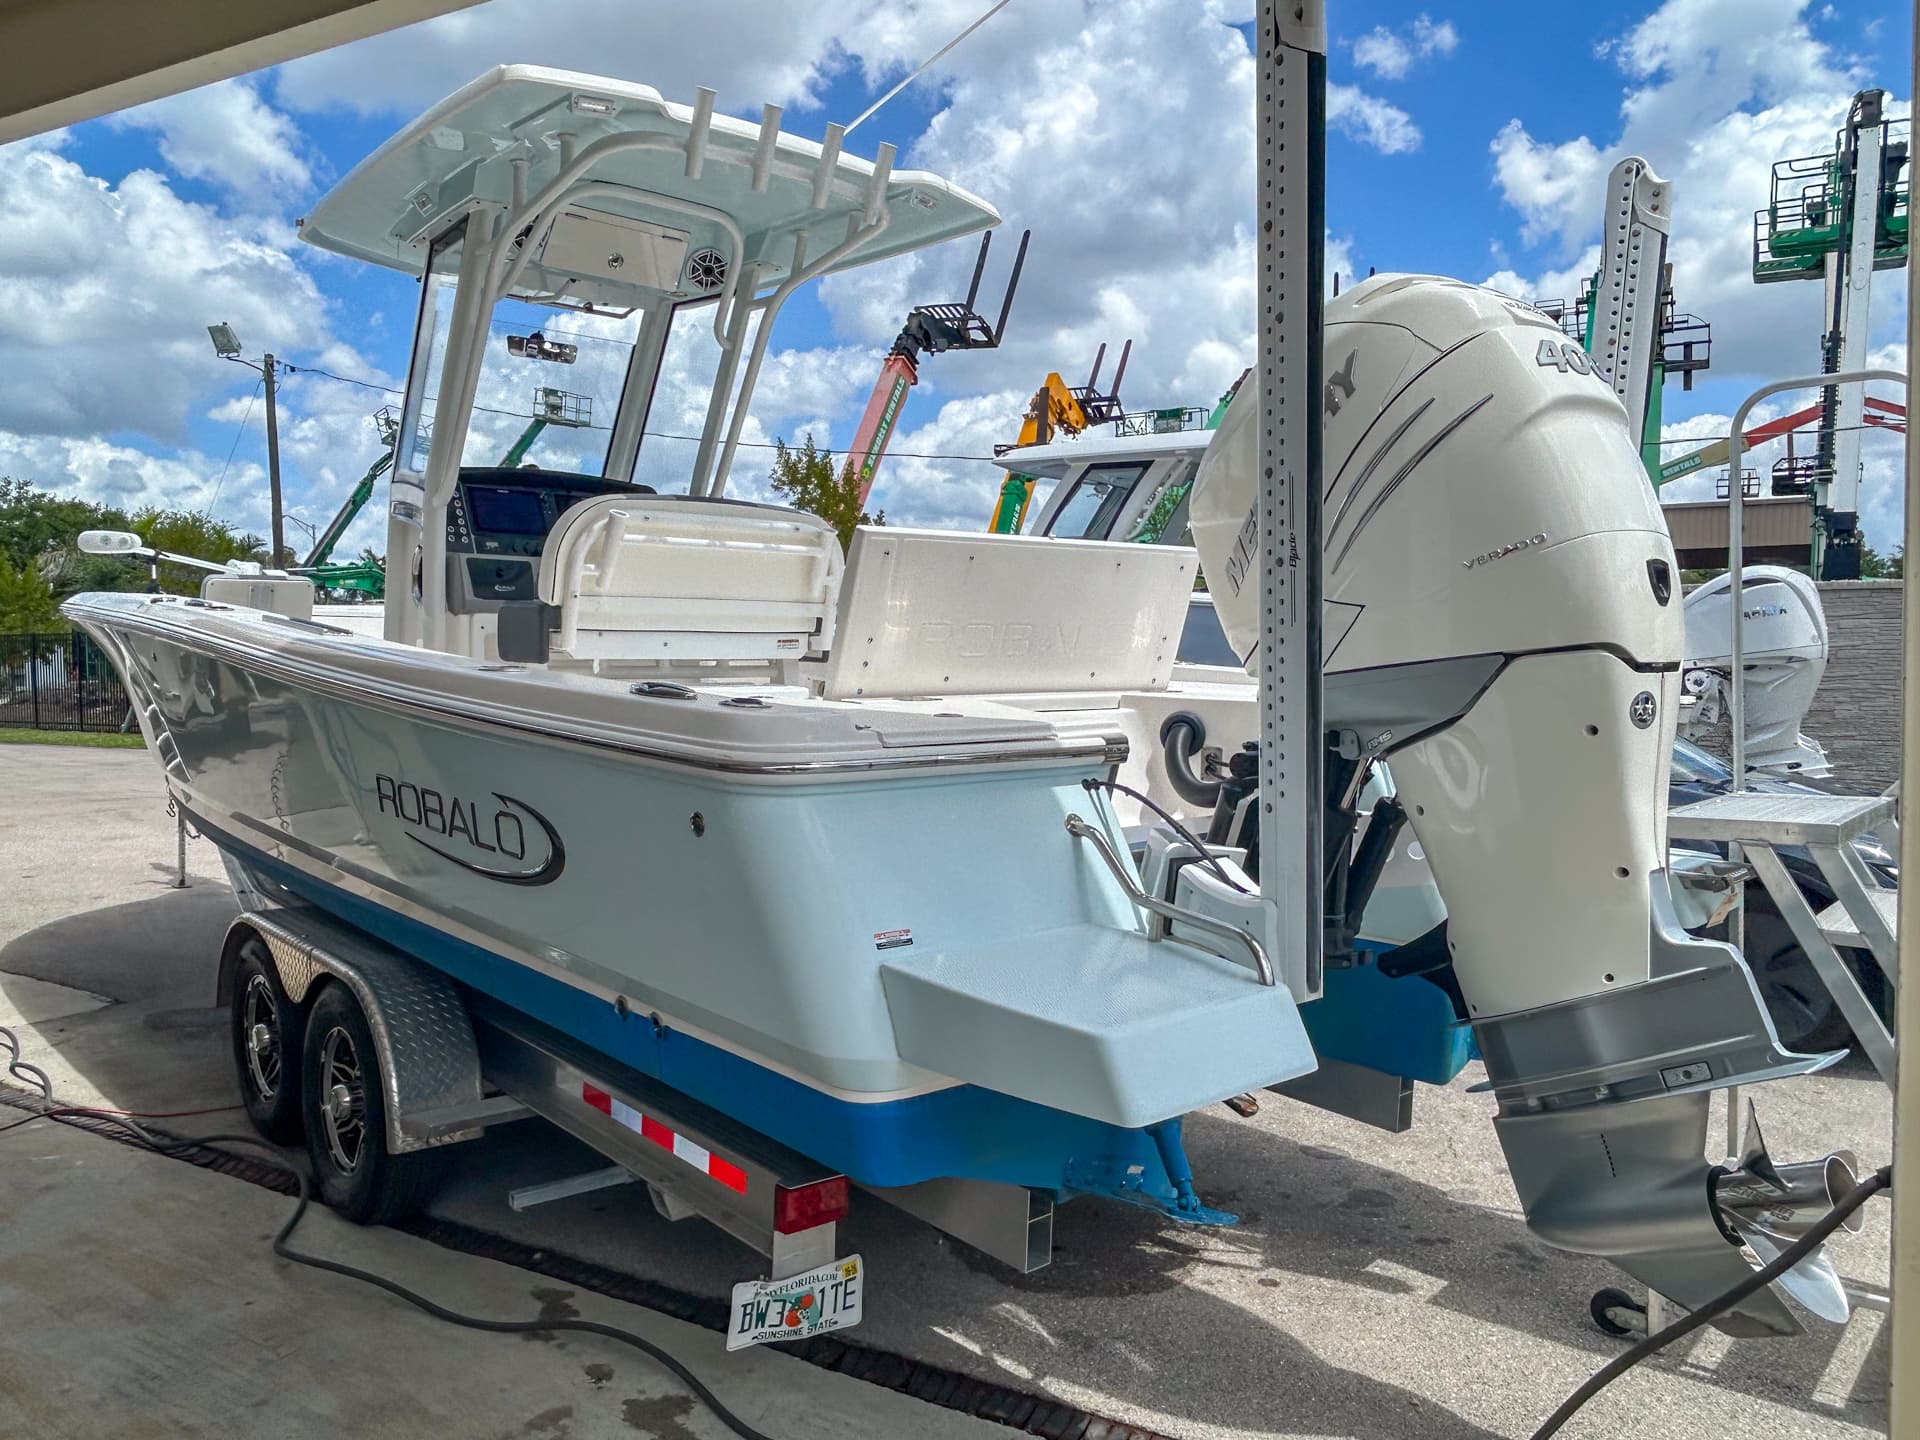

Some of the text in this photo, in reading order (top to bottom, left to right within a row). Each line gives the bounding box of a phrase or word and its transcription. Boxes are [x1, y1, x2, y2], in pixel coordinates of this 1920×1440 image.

[1463, 532, 1548, 570] VERADO
[375, 773, 525, 860] ROBALO
[737, 1276, 857, 1335] BW3 1TE
[757, 1319, 834, 1341] SUNSHINE STATE
